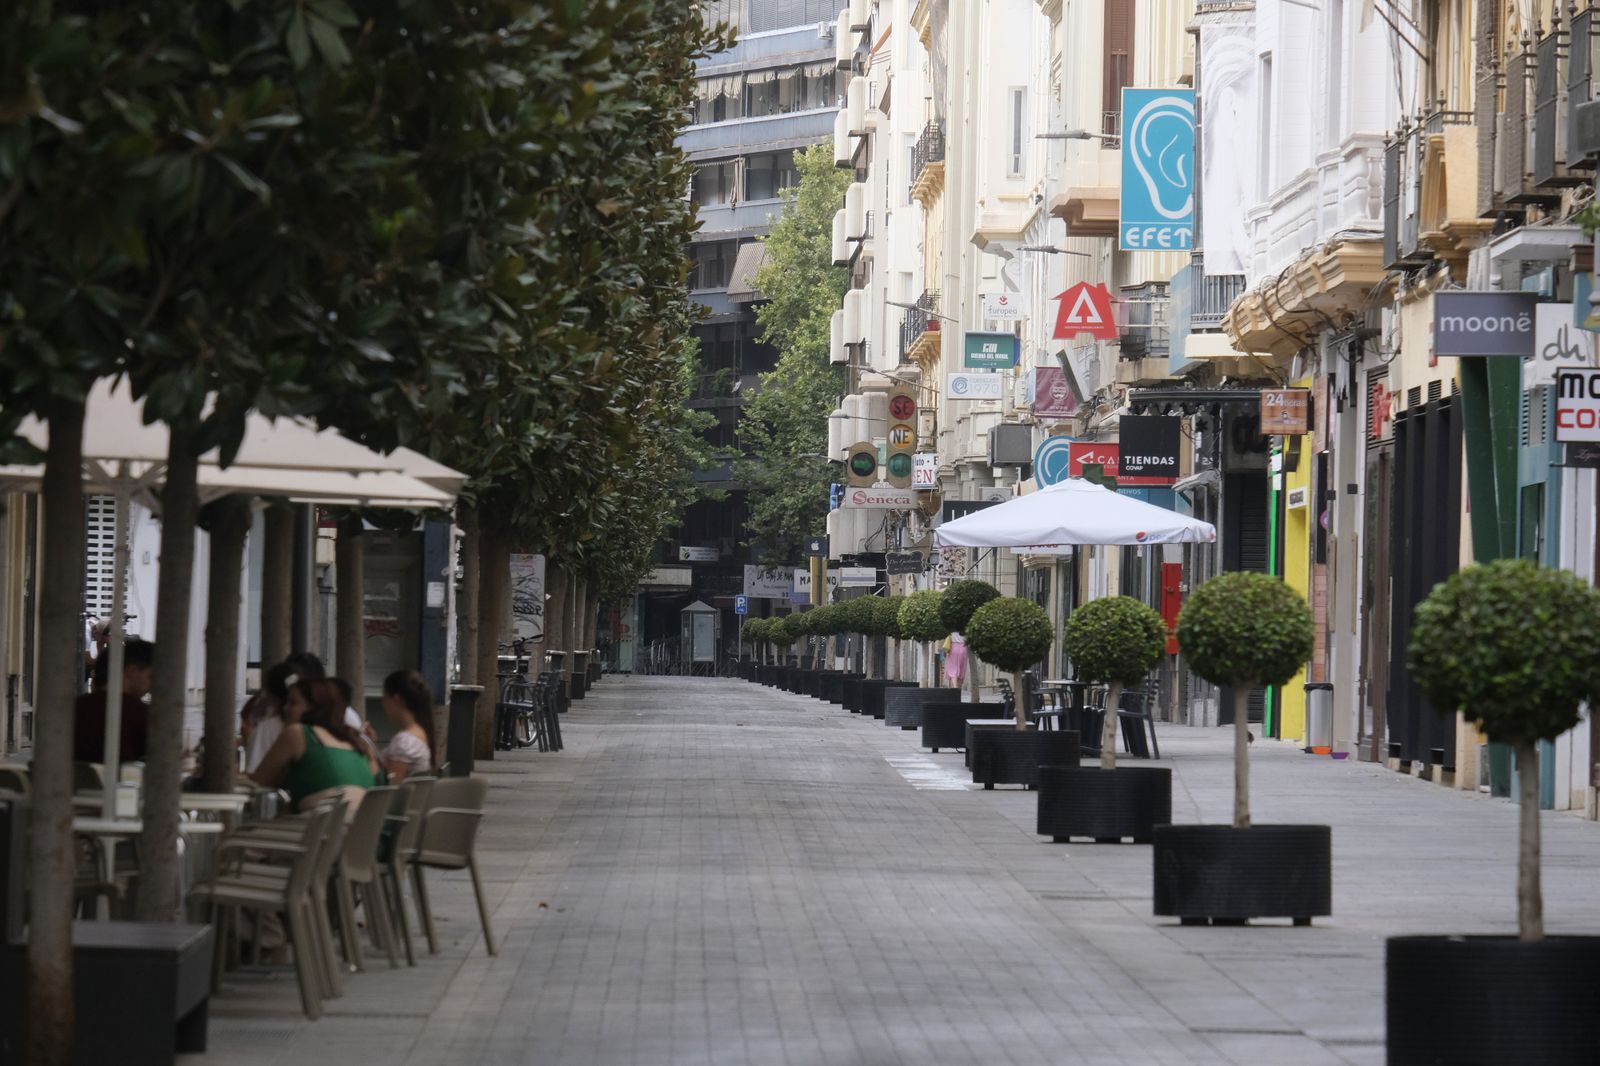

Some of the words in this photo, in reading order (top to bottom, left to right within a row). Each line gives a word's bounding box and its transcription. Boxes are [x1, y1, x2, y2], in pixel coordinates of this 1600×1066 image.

[1440, 312, 1532, 333] moonë
[1266, 393, 1284, 407] 24
[893, 429, 910, 444] NE
[1125, 455, 1175, 466] TIENDAS
[852, 491, 911, 504] Seneca
